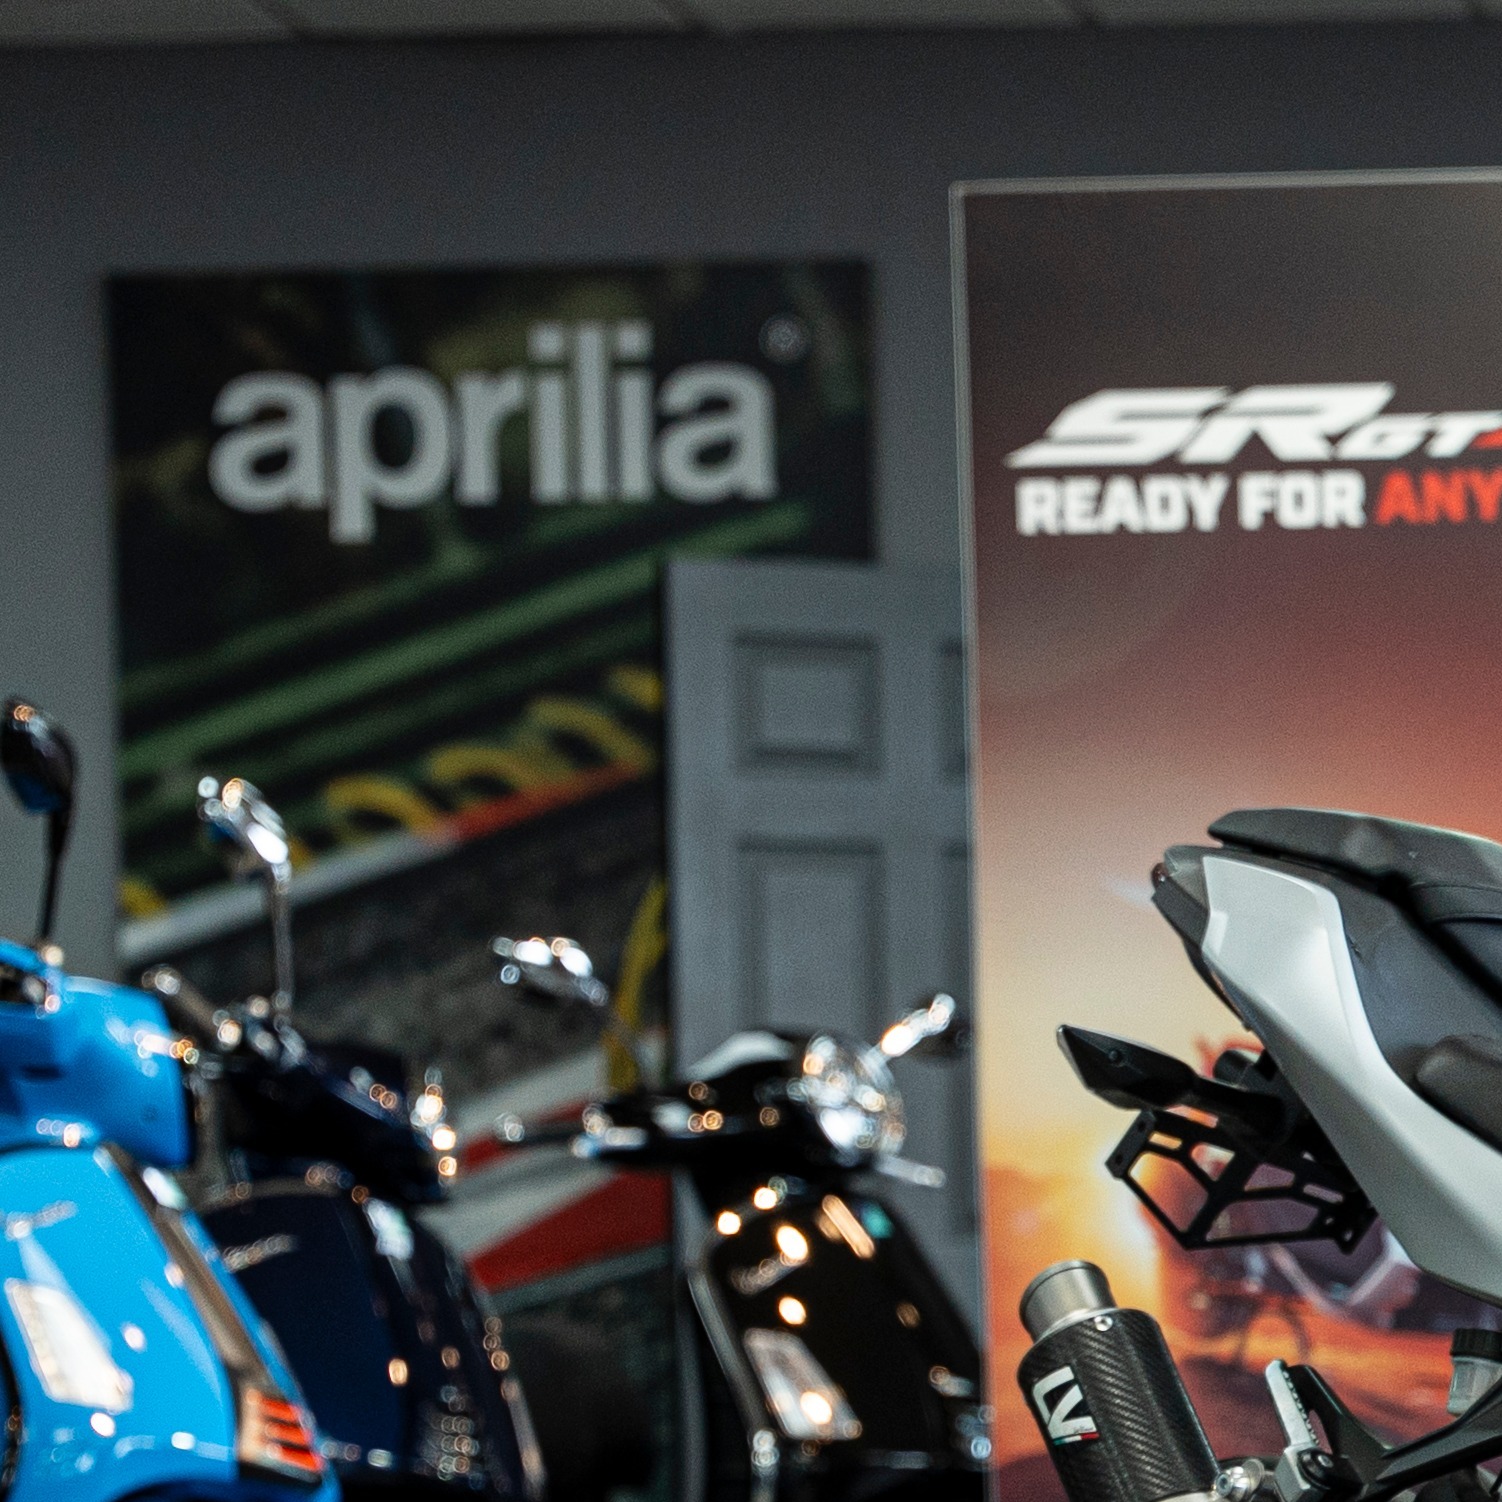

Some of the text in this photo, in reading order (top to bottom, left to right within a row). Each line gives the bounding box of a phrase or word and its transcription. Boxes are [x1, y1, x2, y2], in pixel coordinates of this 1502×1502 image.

[207, 320, 780, 545] aprilia
[1004, 380, 1397, 469] SR
[1015, 473, 1229, 536] READY
[1237, 469, 1366, 531] FOR
